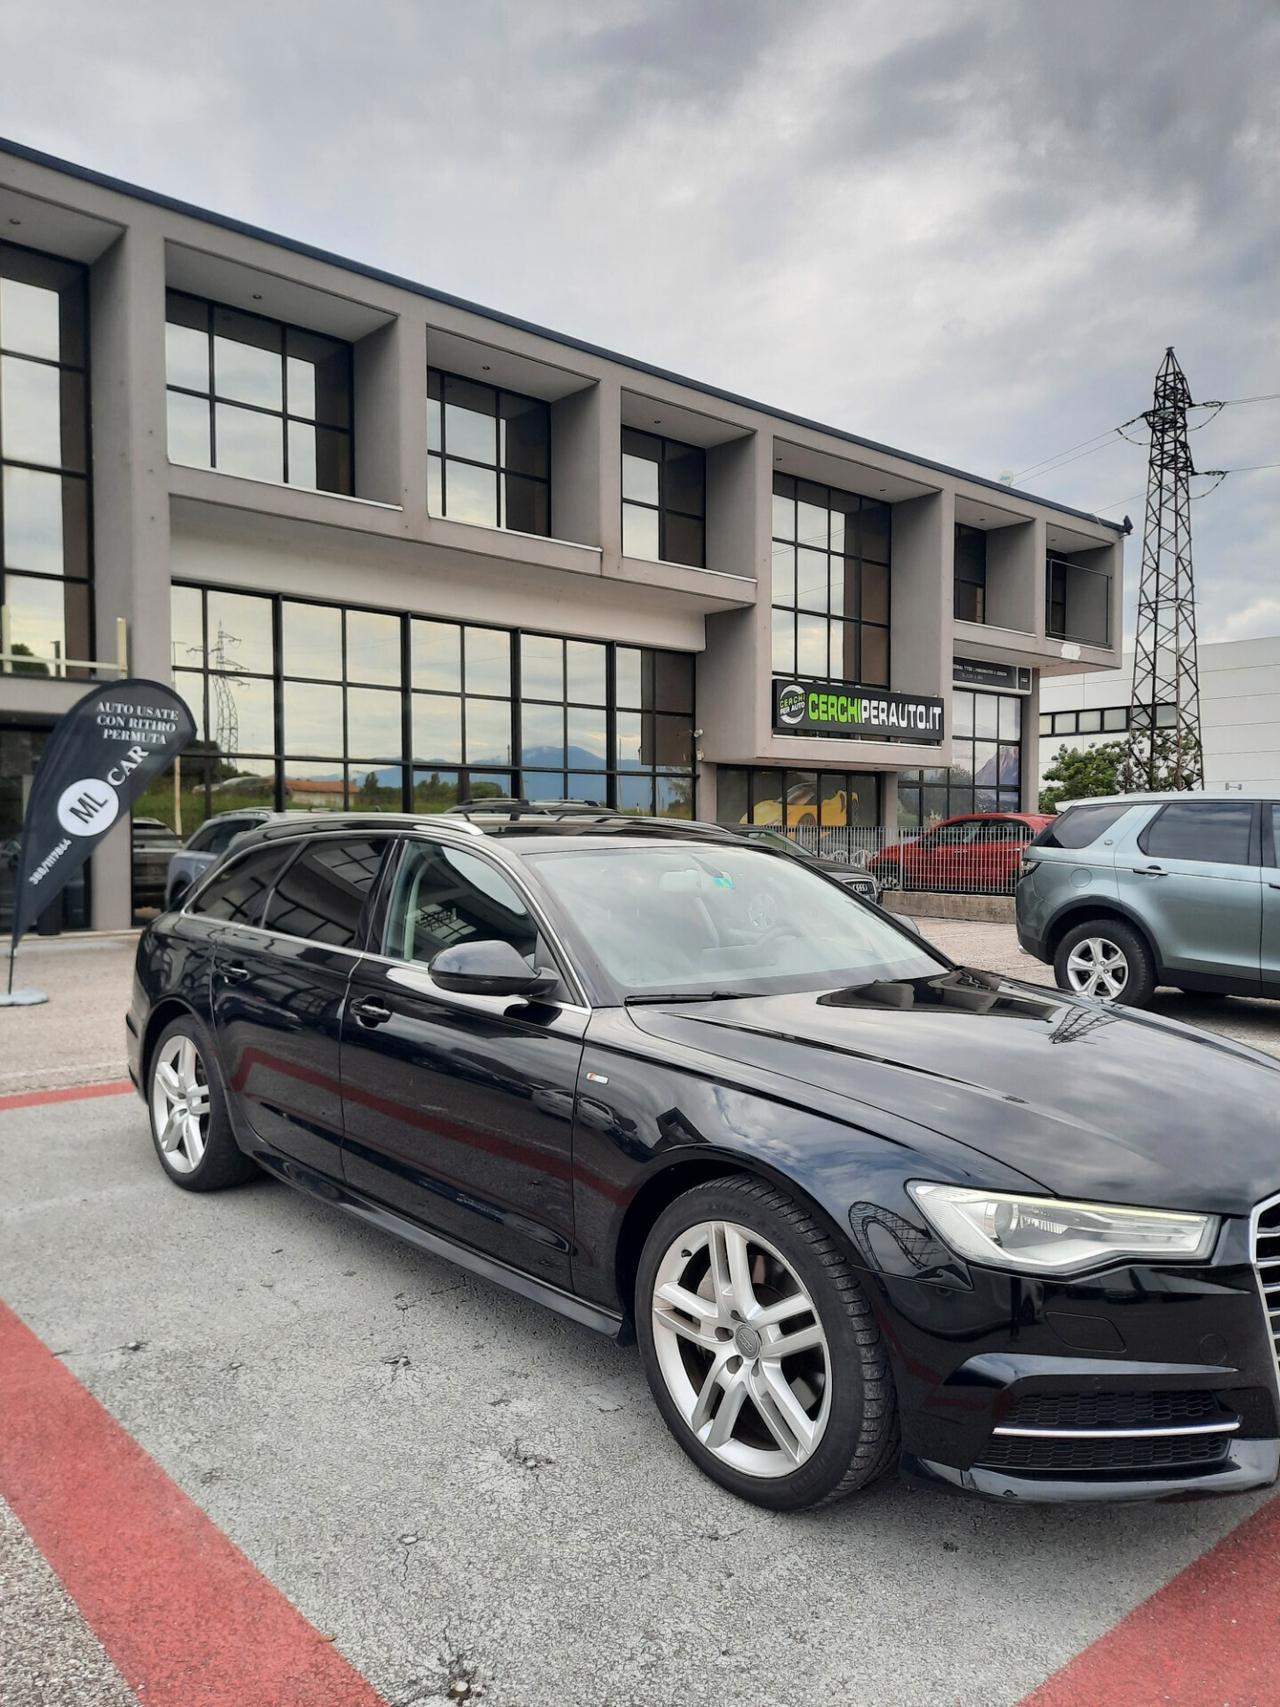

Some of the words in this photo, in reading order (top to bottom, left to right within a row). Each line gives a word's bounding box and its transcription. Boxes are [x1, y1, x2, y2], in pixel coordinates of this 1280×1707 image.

[779, 693, 806, 708] CERCHI
[790, 701, 806, 712] AUTO
[96, 701, 134, 715] AUTO
[136, 705, 179, 721] USATE
[808, 692, 942, 730] CERCHIPERAUTO.IT
[96, 715, 125, 728] CON
[128, 717, 176, 733] RITIRO
[103, 728, 167, 745] PERMUTA
[69, 792, 108, 824] ML
[107, 745, 150, 786] CAR
